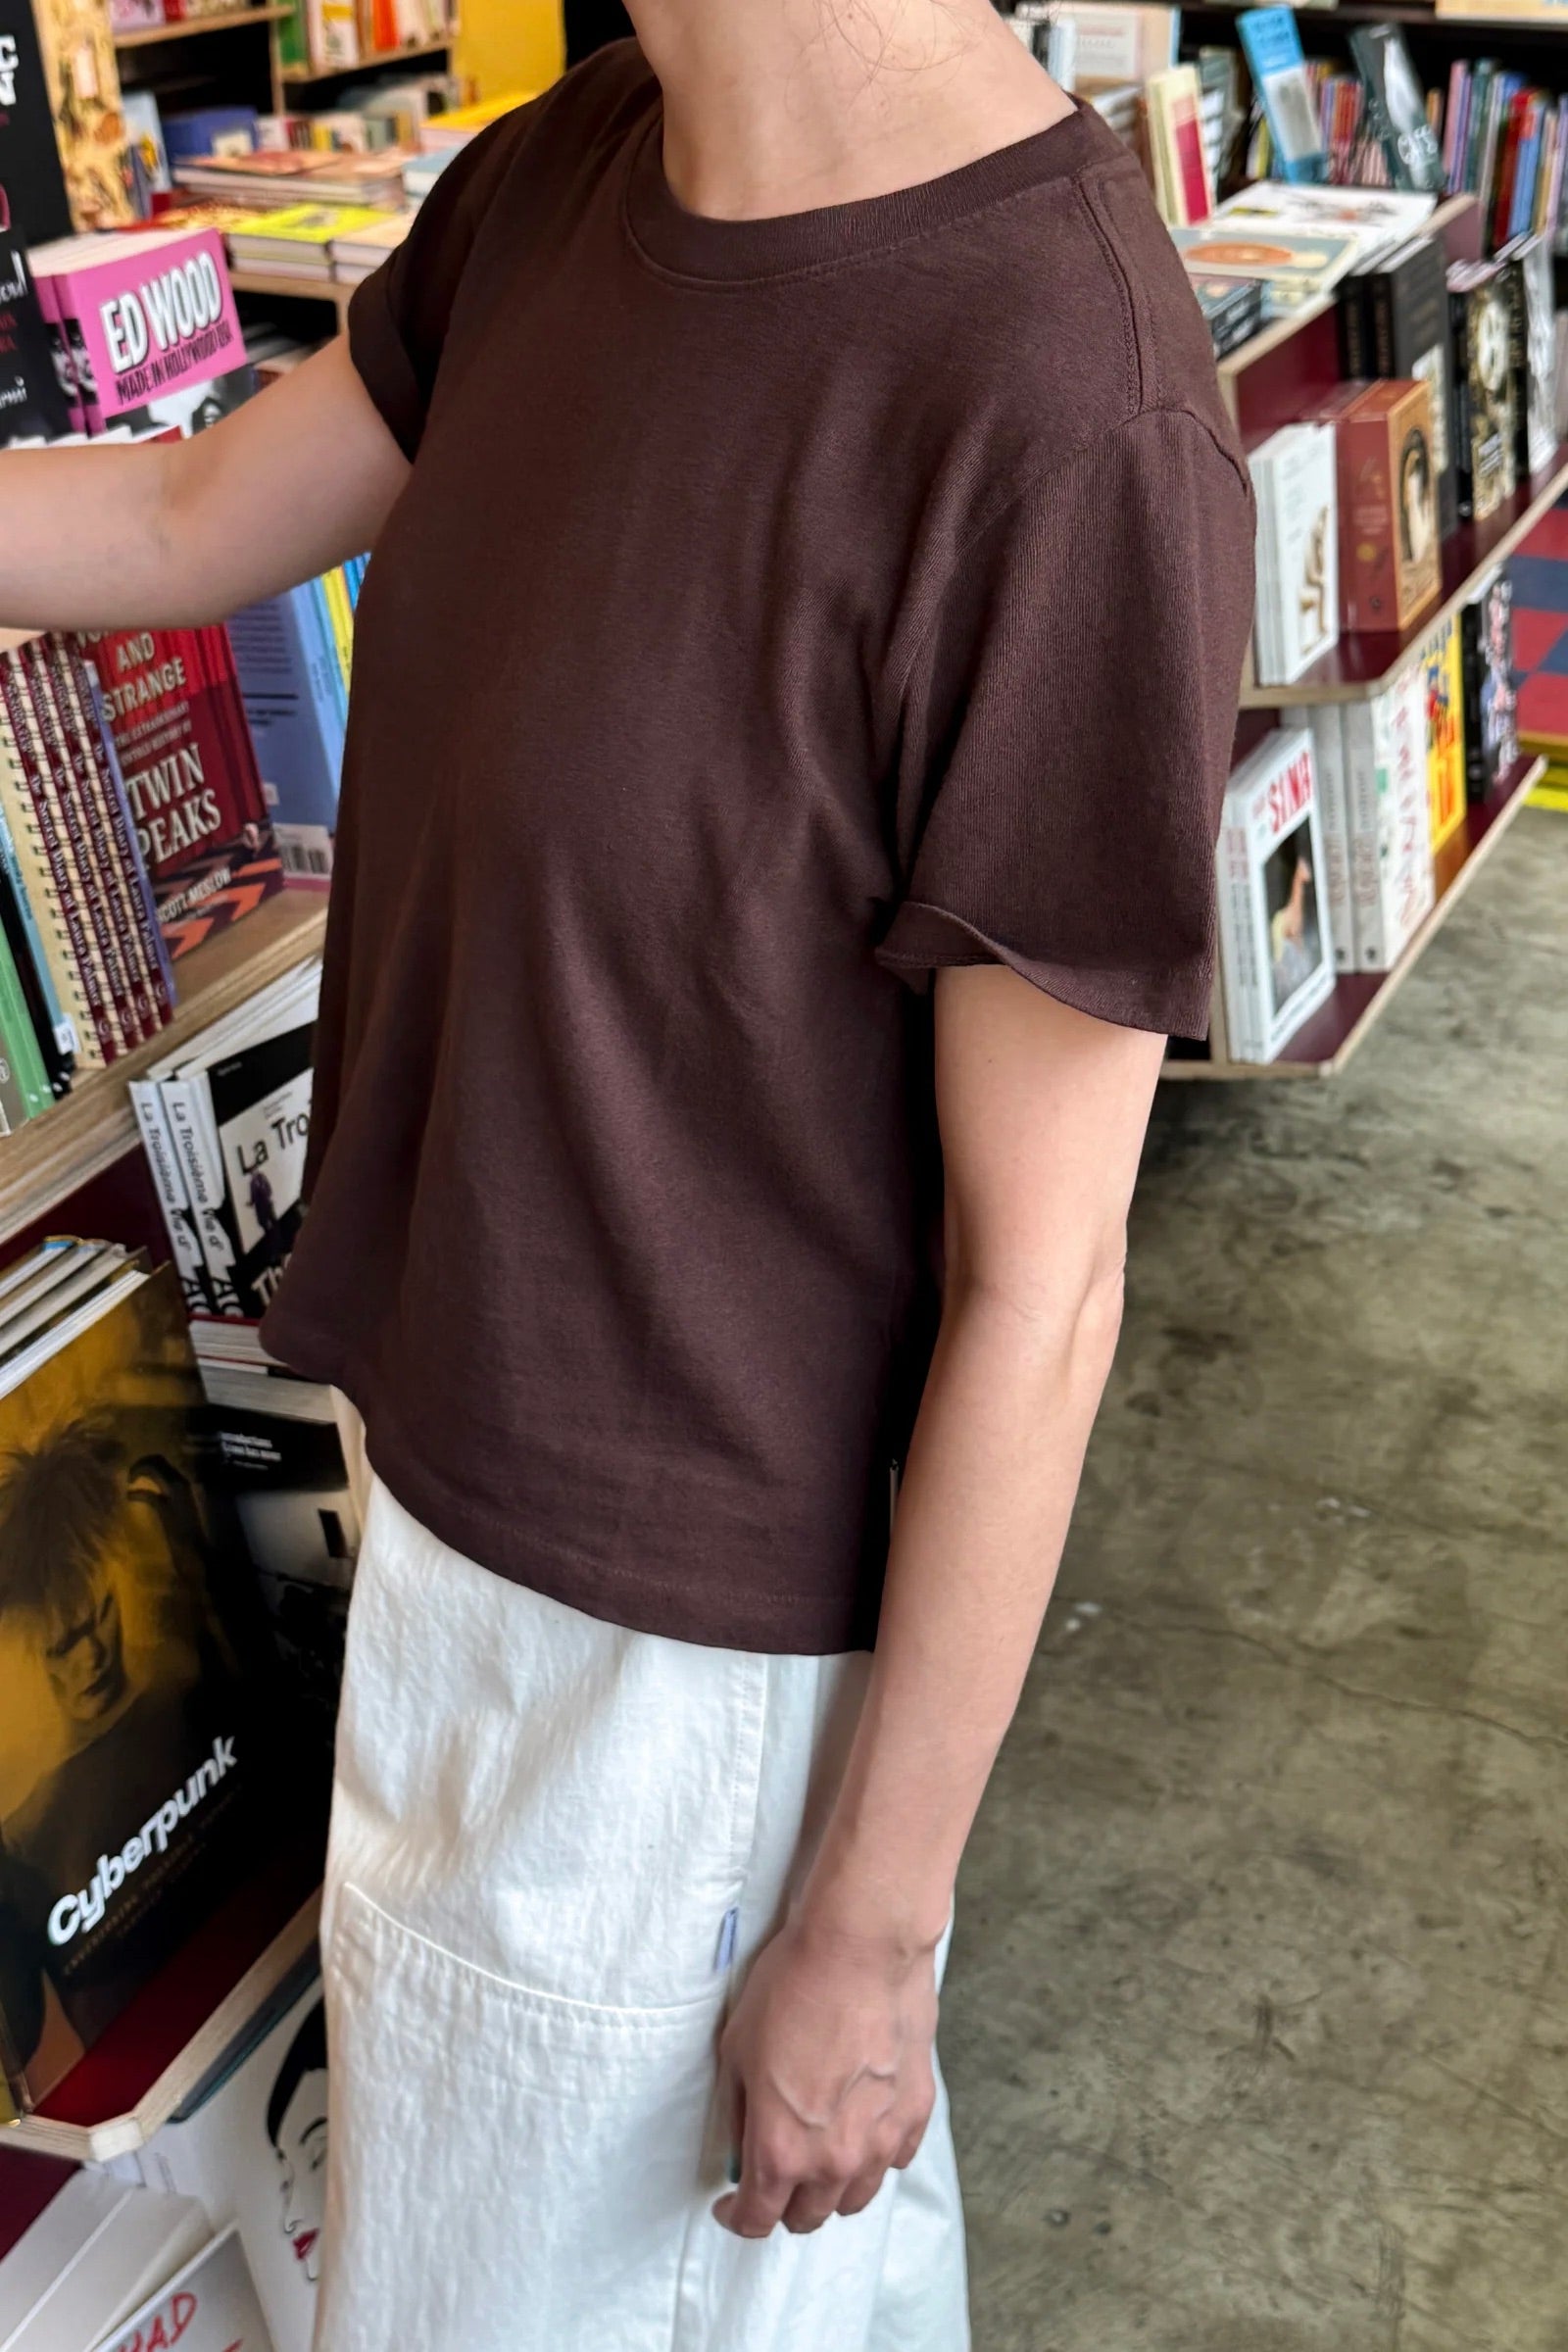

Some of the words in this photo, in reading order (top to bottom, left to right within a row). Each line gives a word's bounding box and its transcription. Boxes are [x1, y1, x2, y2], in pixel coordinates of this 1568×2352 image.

[101, 291, 149, 374] ED
[139, 251, 222, 352] WOOD
[116, 632, 155, 673] AND
[100, 657, 186, 721] STRANGE
[125, 743, 205, 821] TWIN
[138, 788, 221, 868] PEAKS
[140, 1102, 154, 1122] La
[172, 1102, 186, 1122] La
[237, 1139, 270, 1176] La
[271, 1110, 311, 1150] Tro
[48, 1735, 238, 1946] Cyberpunk
